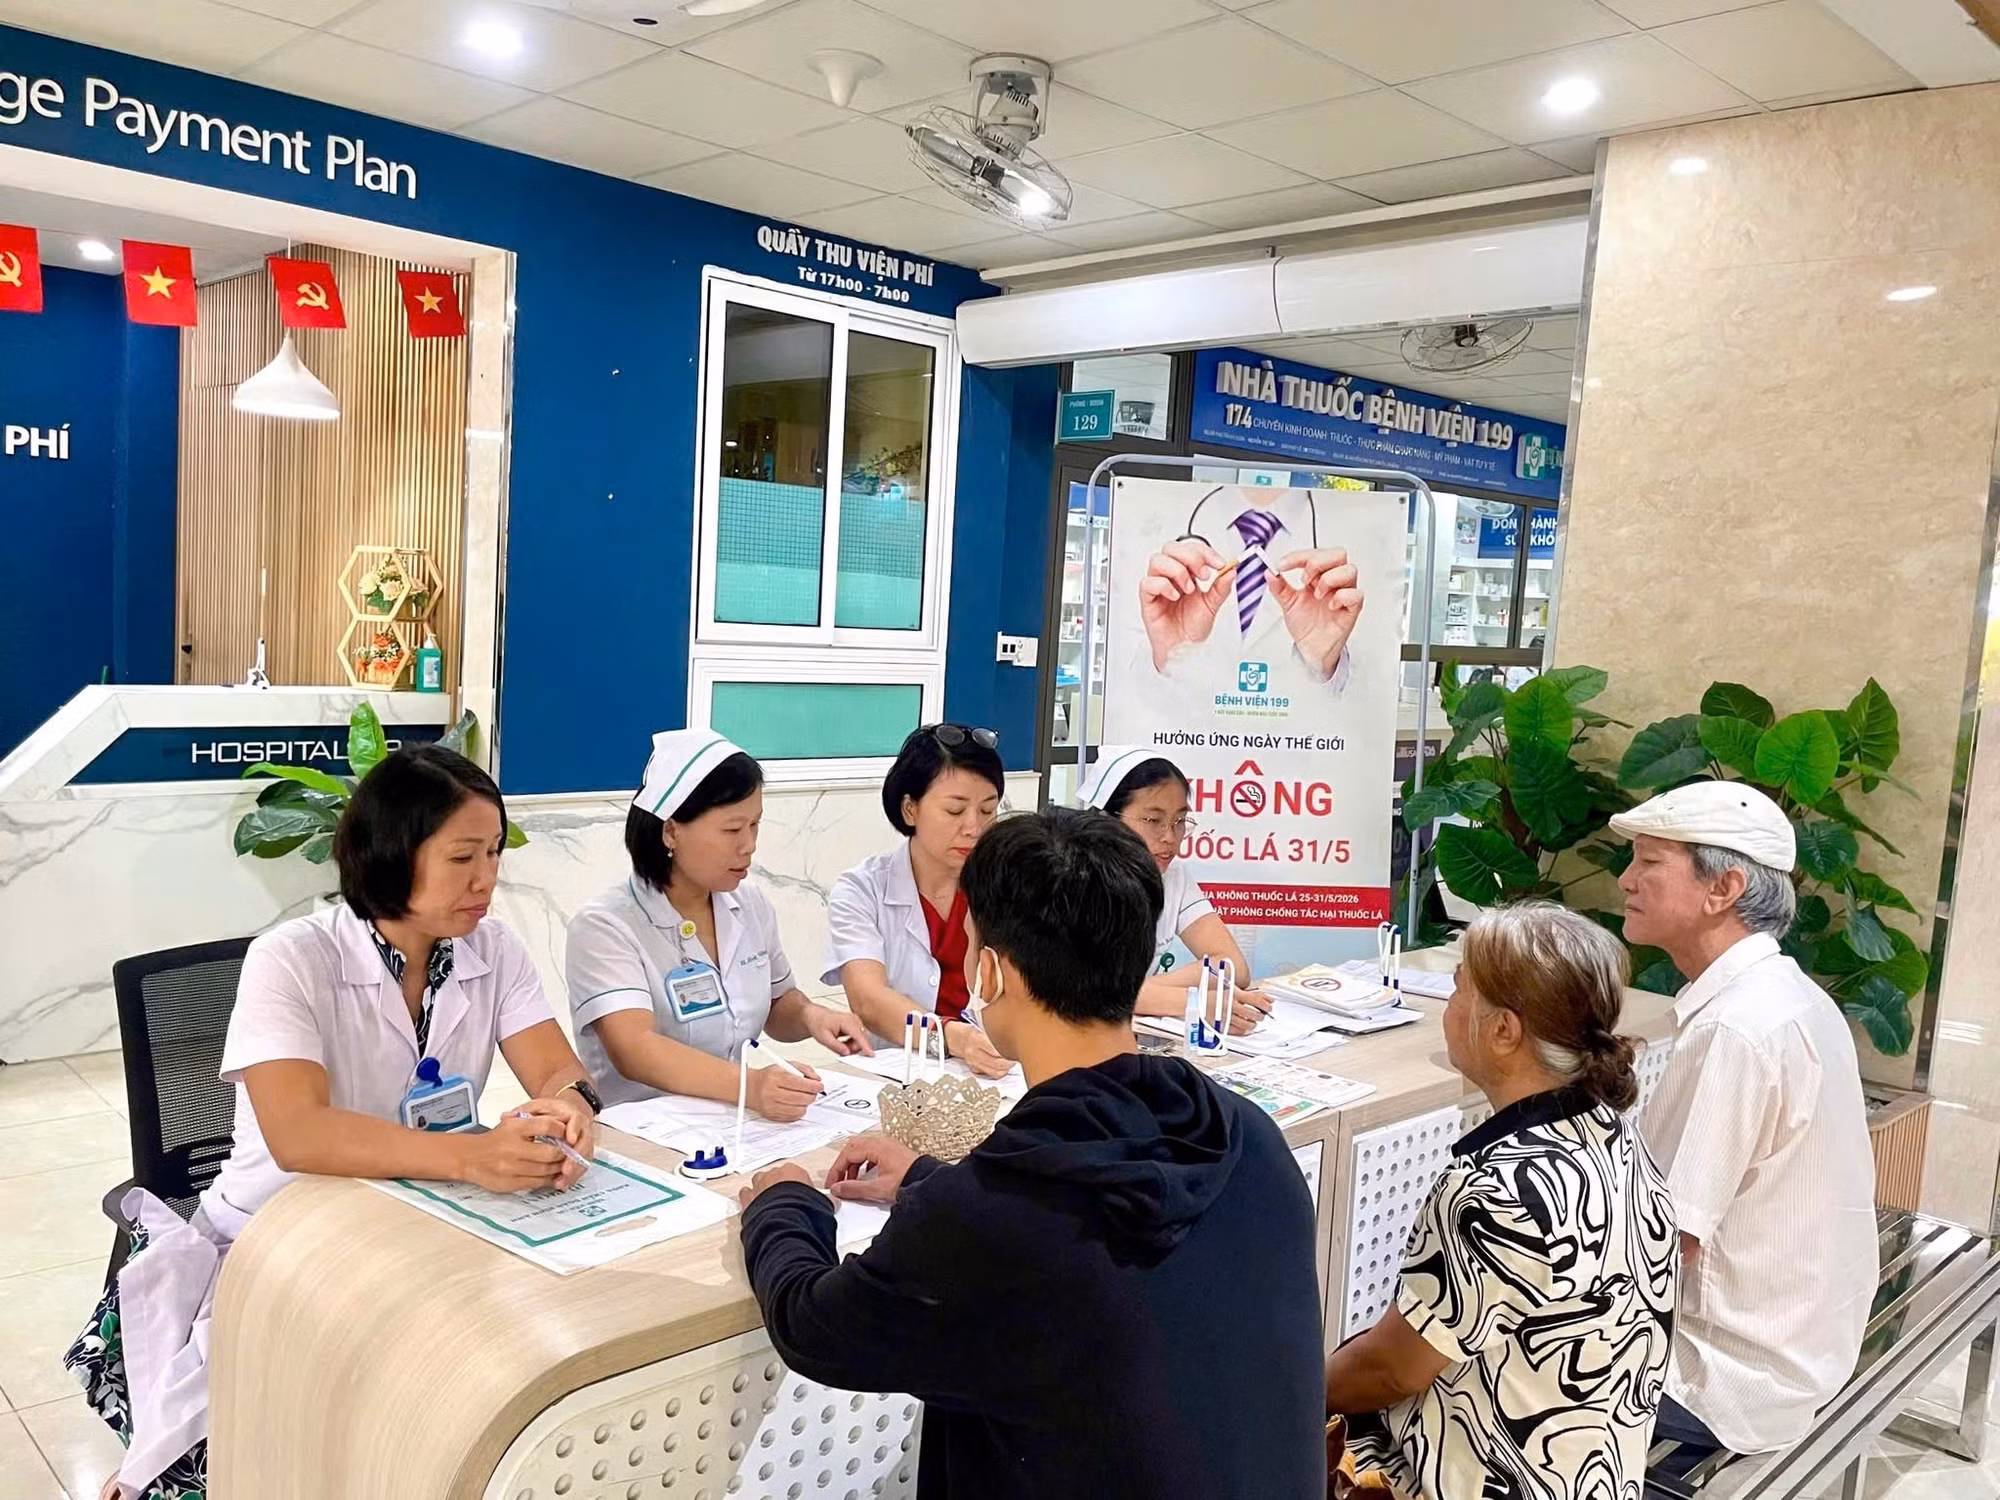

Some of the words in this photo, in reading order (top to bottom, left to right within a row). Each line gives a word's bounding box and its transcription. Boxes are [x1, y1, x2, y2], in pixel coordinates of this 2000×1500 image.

[84, 77, 311, 175] Payment
[326, 134, 417, 199] Plan
[757, 225, 811, 258] QUẦY
[814, 238, 853, 268] THU
[857, 250, 899, 282] VIỆN
[903, 260, 936, 287] PHÍ
[797, 266, 818, 283] Từ
[819, 273, 864, 293] 17h00
[874, 284, 910, 303] 7h00
[1216, 360, 1277, 403] NHÀ
[1278, 377, 1364, 420] THUỐC
[1363, 389, 1425, 435] BỆNH
[1426, 405, 1476, 448] VIỆN
[1476, 420, 1513, 450] 199
[1226, 403, 1253, 429] 174
[1073, 414, 1099, 431] 129
[1284, 422, 1302, 436] KINH
[1302, 426, 1328, 441] DOANH
[5, 423, 71, 460] PHÍ
[1215, 693, 1242, 707] BỆNH
[1245, 694, 1268, 709] VIỆN
[1270, 697, 1289, 708] 199
[191, 740, 349, 764] HOSPITAL
[1153, 729, 1205, 746] HƯỞNG
[1208, 731, 1239, 747] ỨNG
[1243, 733, 1281, 749] NGÀY
[1285, 734, 1312, 750] THẾ
[1316, 735, 1344, 751] GIỚI
[1177, 829, 1235, 860] UỐC
[1243, 832, 1280, 861] LÁ
[1288, 838, 1351, 865] 31/5
[1216, 889, 1249, 900] KHÔNG
[1251, 890, 1283, 901] THUỐC
[1285, 891, 1297, 902] LÁ
[1299, 892, 1360, 904] 25-31/5/2026
[1230, 906, 1263, 917] PHÒNG
[1265, 906, 1299, 918] CHỐNG
[1299, 908, 1318, 919] TÁC
[1319, 911, 1337, 921] HẠI
[1338, 908, 1370, 920] THUỐC
[1371, 909, 1384, 920] LÁ
